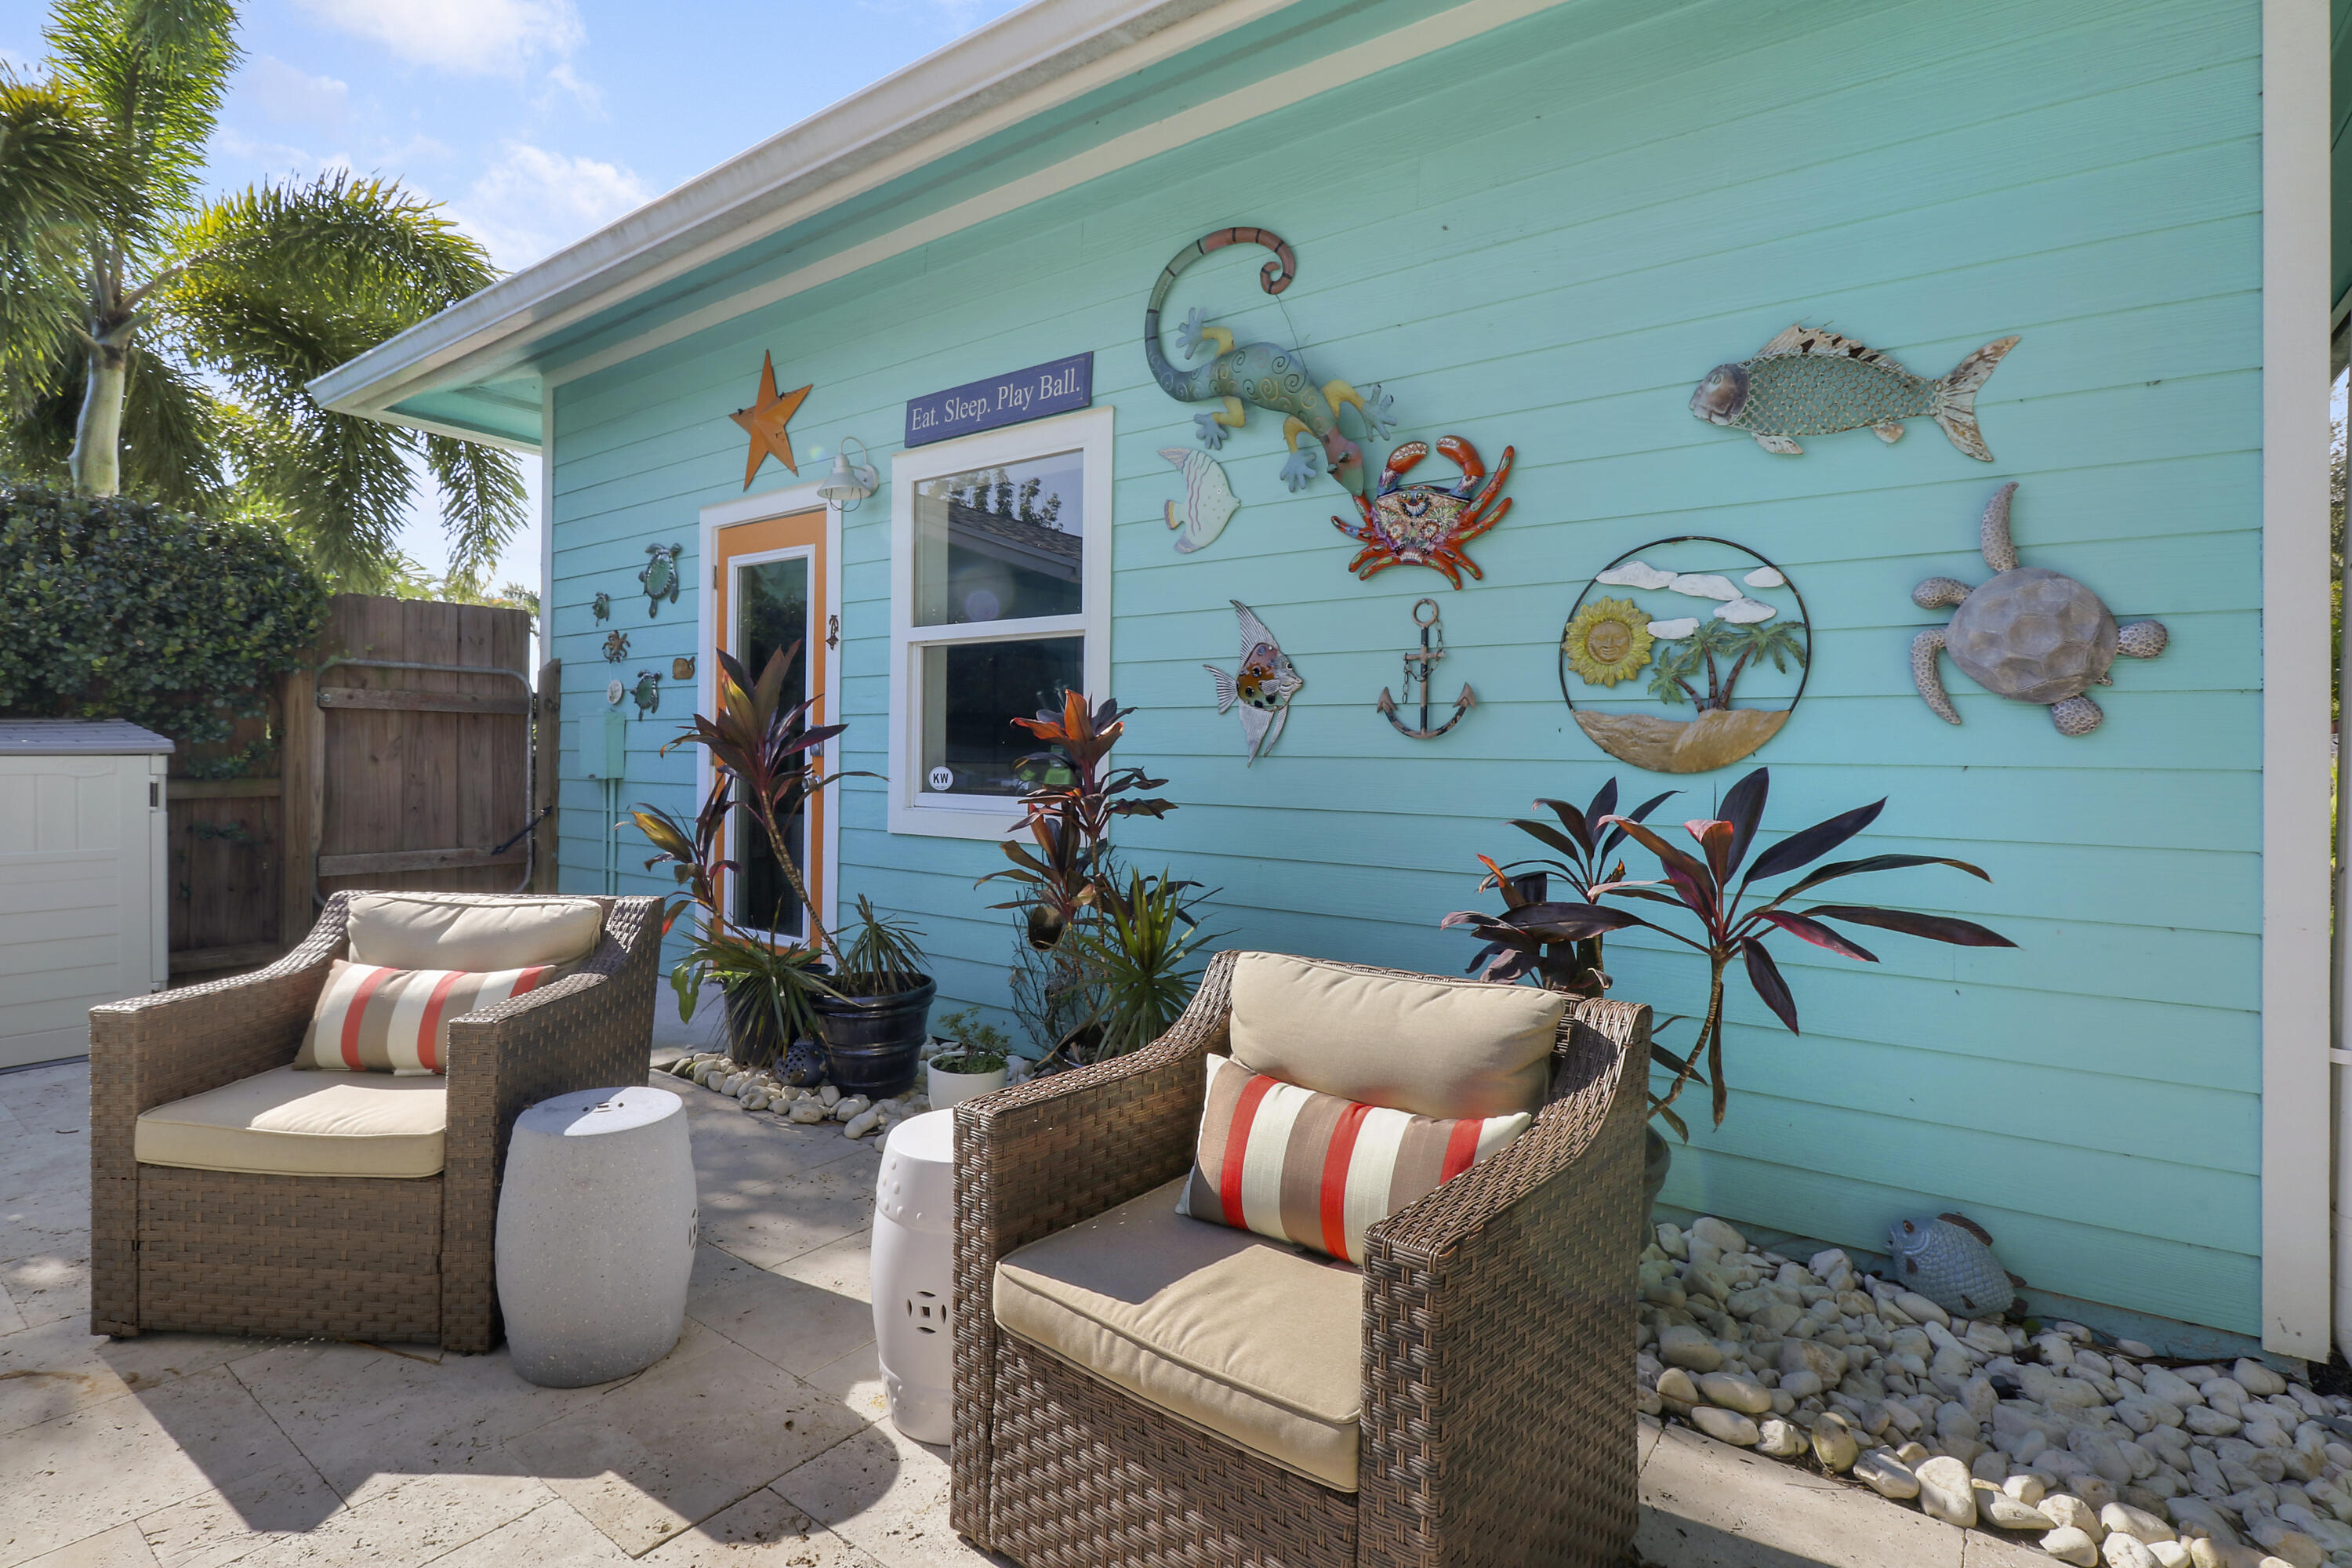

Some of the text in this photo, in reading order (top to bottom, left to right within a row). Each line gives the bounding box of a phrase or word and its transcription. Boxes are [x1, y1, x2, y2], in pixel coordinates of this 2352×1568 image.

[911, 367, 1080, 431] Eat. Sleep. Play Ball.
[933, 773, 949, 784] KW
